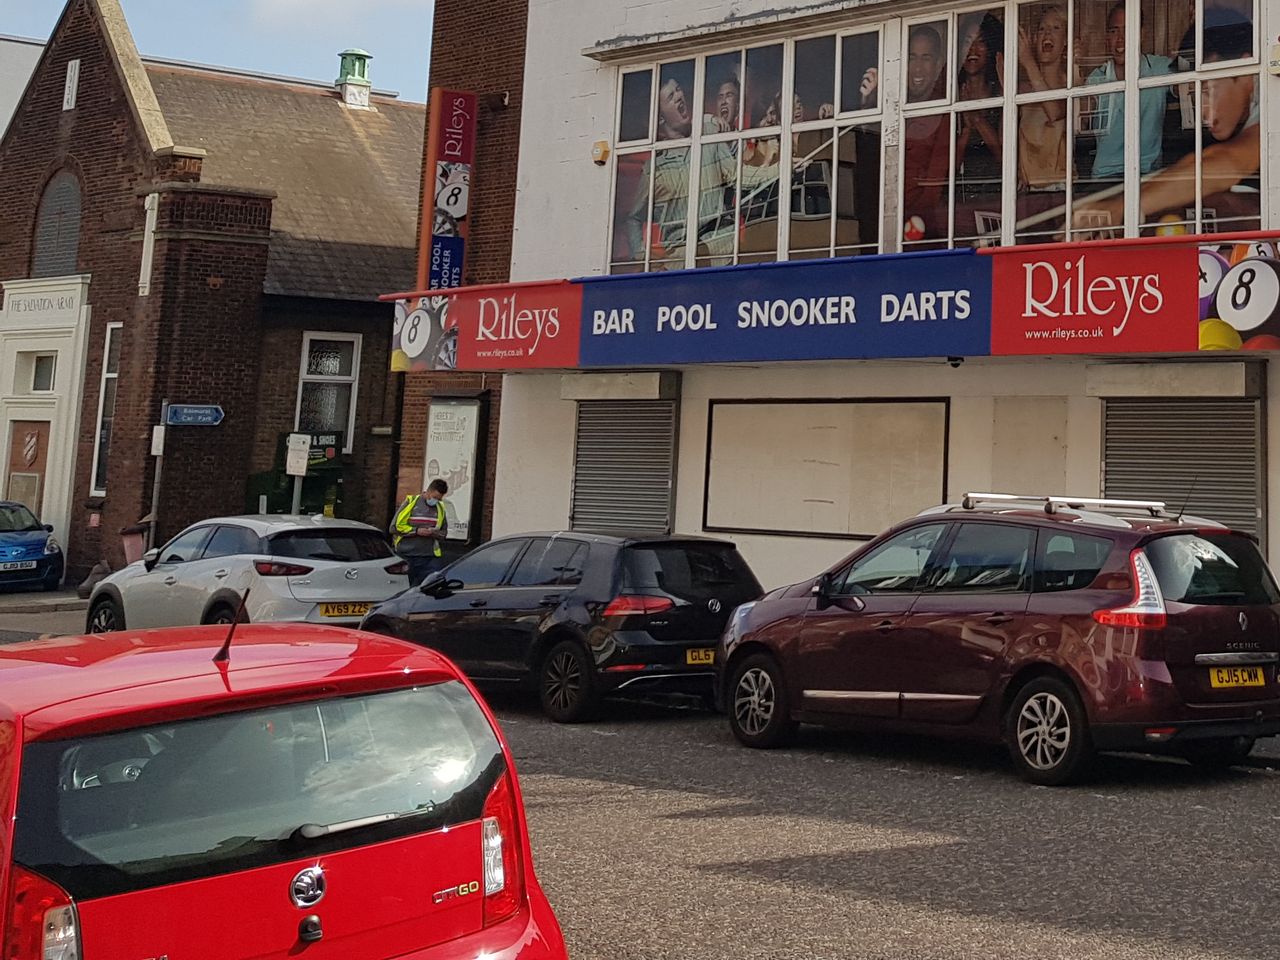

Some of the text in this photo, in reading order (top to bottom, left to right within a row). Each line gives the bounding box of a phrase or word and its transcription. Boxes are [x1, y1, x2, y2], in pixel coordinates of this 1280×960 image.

[444, 97, 470, 157] Rileys
[432, 242, 442, 271] POOL
[1021, 254, 1163, 337] Rileys
[1231, 268, 1257, 311] 8
[11, 300, 22, 312] THE
[592, 289, 971, 335] BAR POOL SNOOKER DARTS
[407, 315, 421, 344] 8
[475, 292, 560, 357] Rileys
[1024, 324, 1104, 341] www.rileys.co.uk
[476, 348, 524, 360] www.rileys.co.uk
[324, 604, 349, 614] AY69
[1226, 641, 1260, 649] SCENIC
[1216, 669, 1240, 683] GJ15
